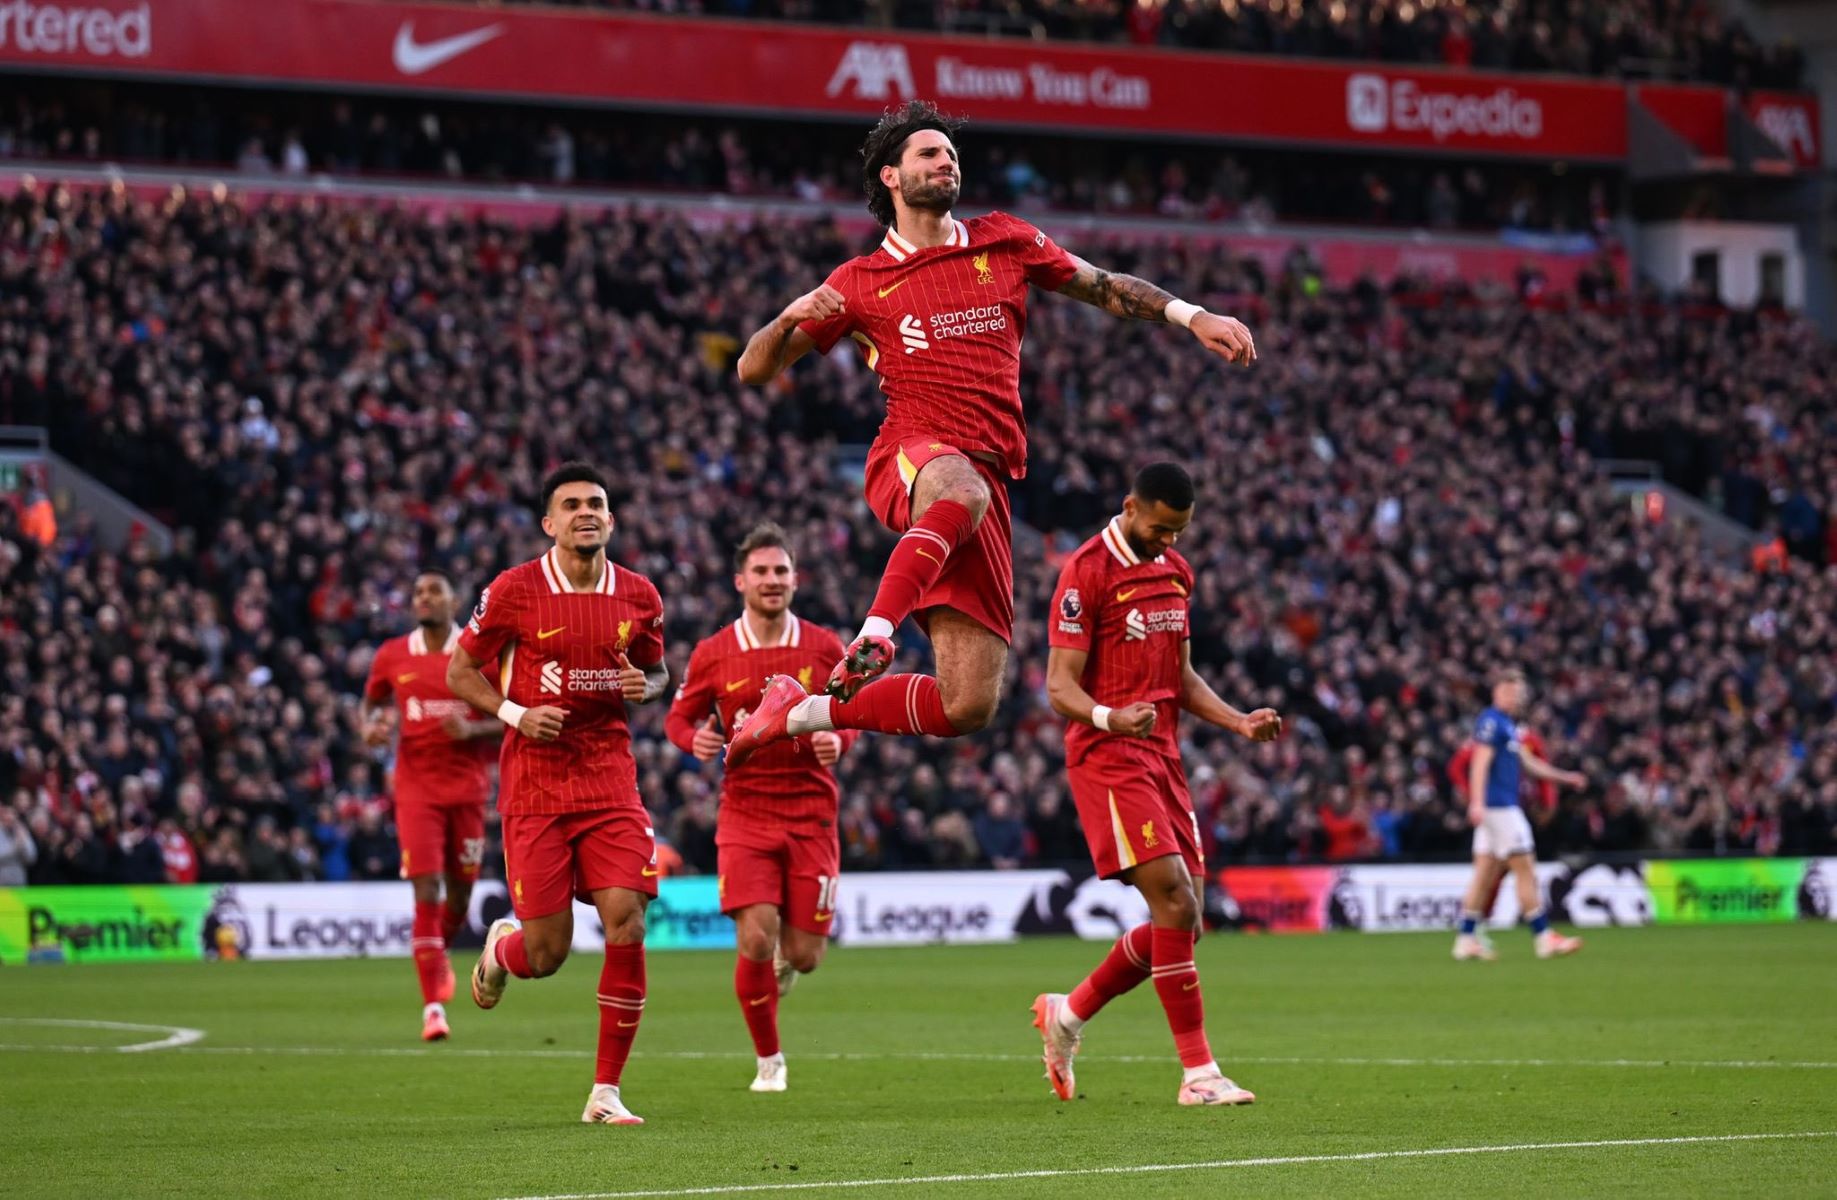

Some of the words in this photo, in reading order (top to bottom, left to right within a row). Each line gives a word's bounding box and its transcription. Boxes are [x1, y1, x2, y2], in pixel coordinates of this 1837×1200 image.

[826, 42, 916, 98] AXA
[936, 56, 1024, 99] Know
[1028, 63, 1087, 106] You
[1090, 68, 1150, 110] Can
[1391, 80, 1542, 139] Expedia
[930, 304, 1001, 327] standard
[933, 317, 1006, 341] chartered
[816, 875, 838, 911] 10
[859, 900, 991, 945] League
